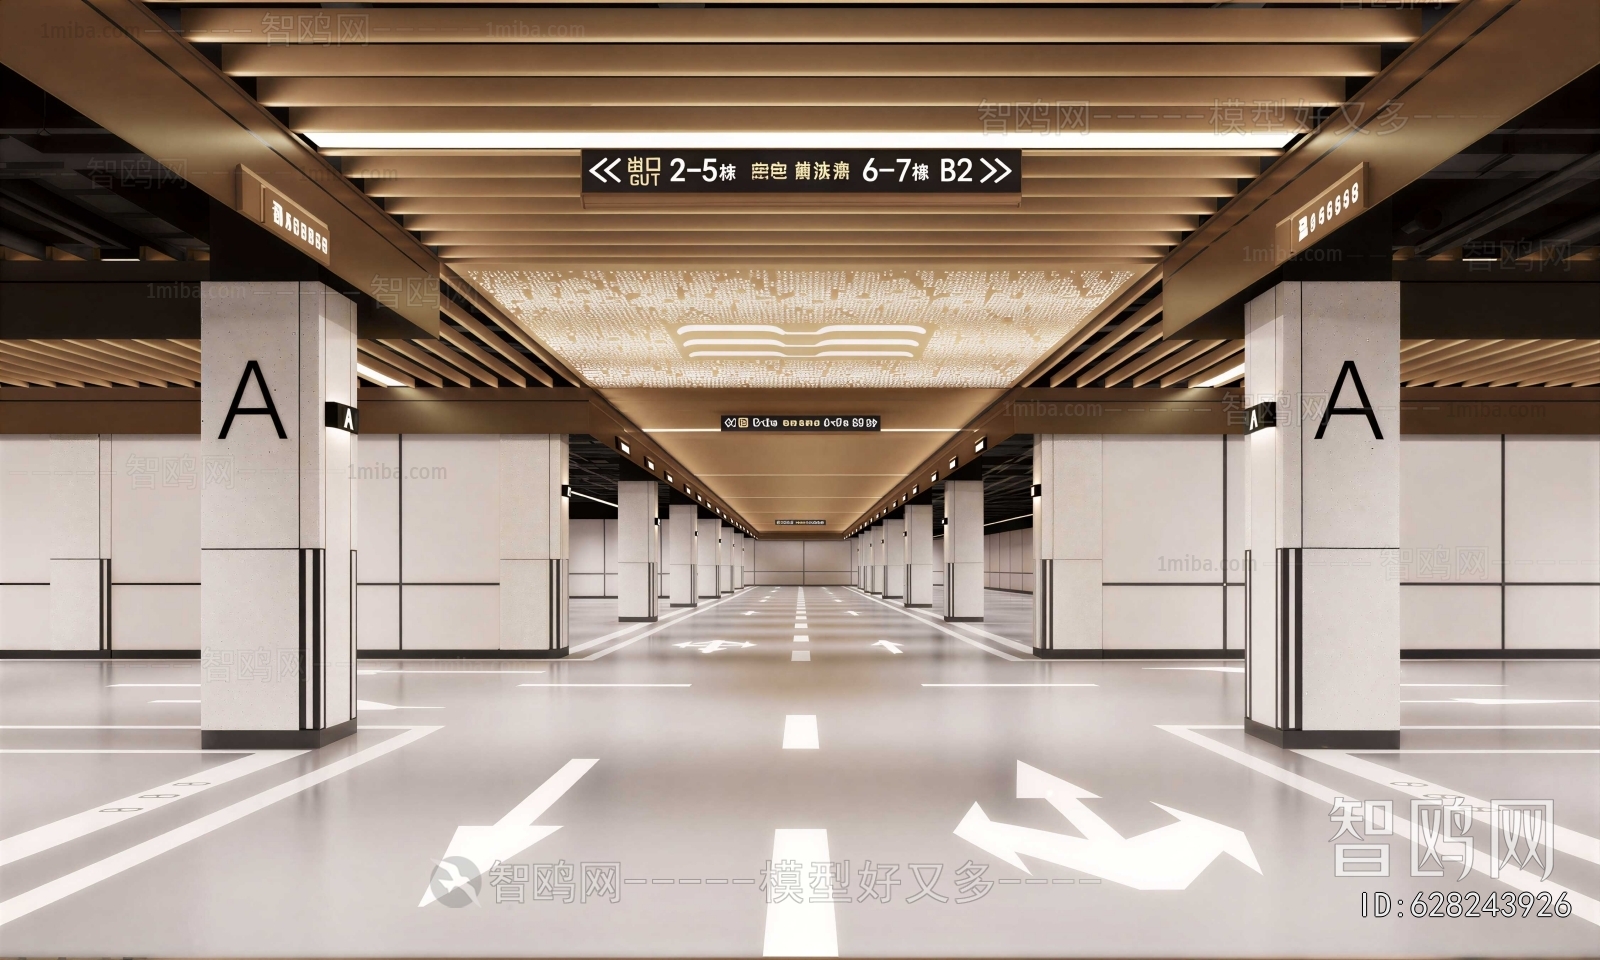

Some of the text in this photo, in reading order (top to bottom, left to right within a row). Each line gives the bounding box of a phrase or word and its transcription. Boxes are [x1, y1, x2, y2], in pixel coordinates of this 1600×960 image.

[630, 173, 660, 186] GUT
[940, 157, 973, 182] B2
[217, 359, 288, 440] A
[1314, 359, 1385, 440] A
[342, 408, 354, 431] A
[1249, 409, 1259, 430] A
